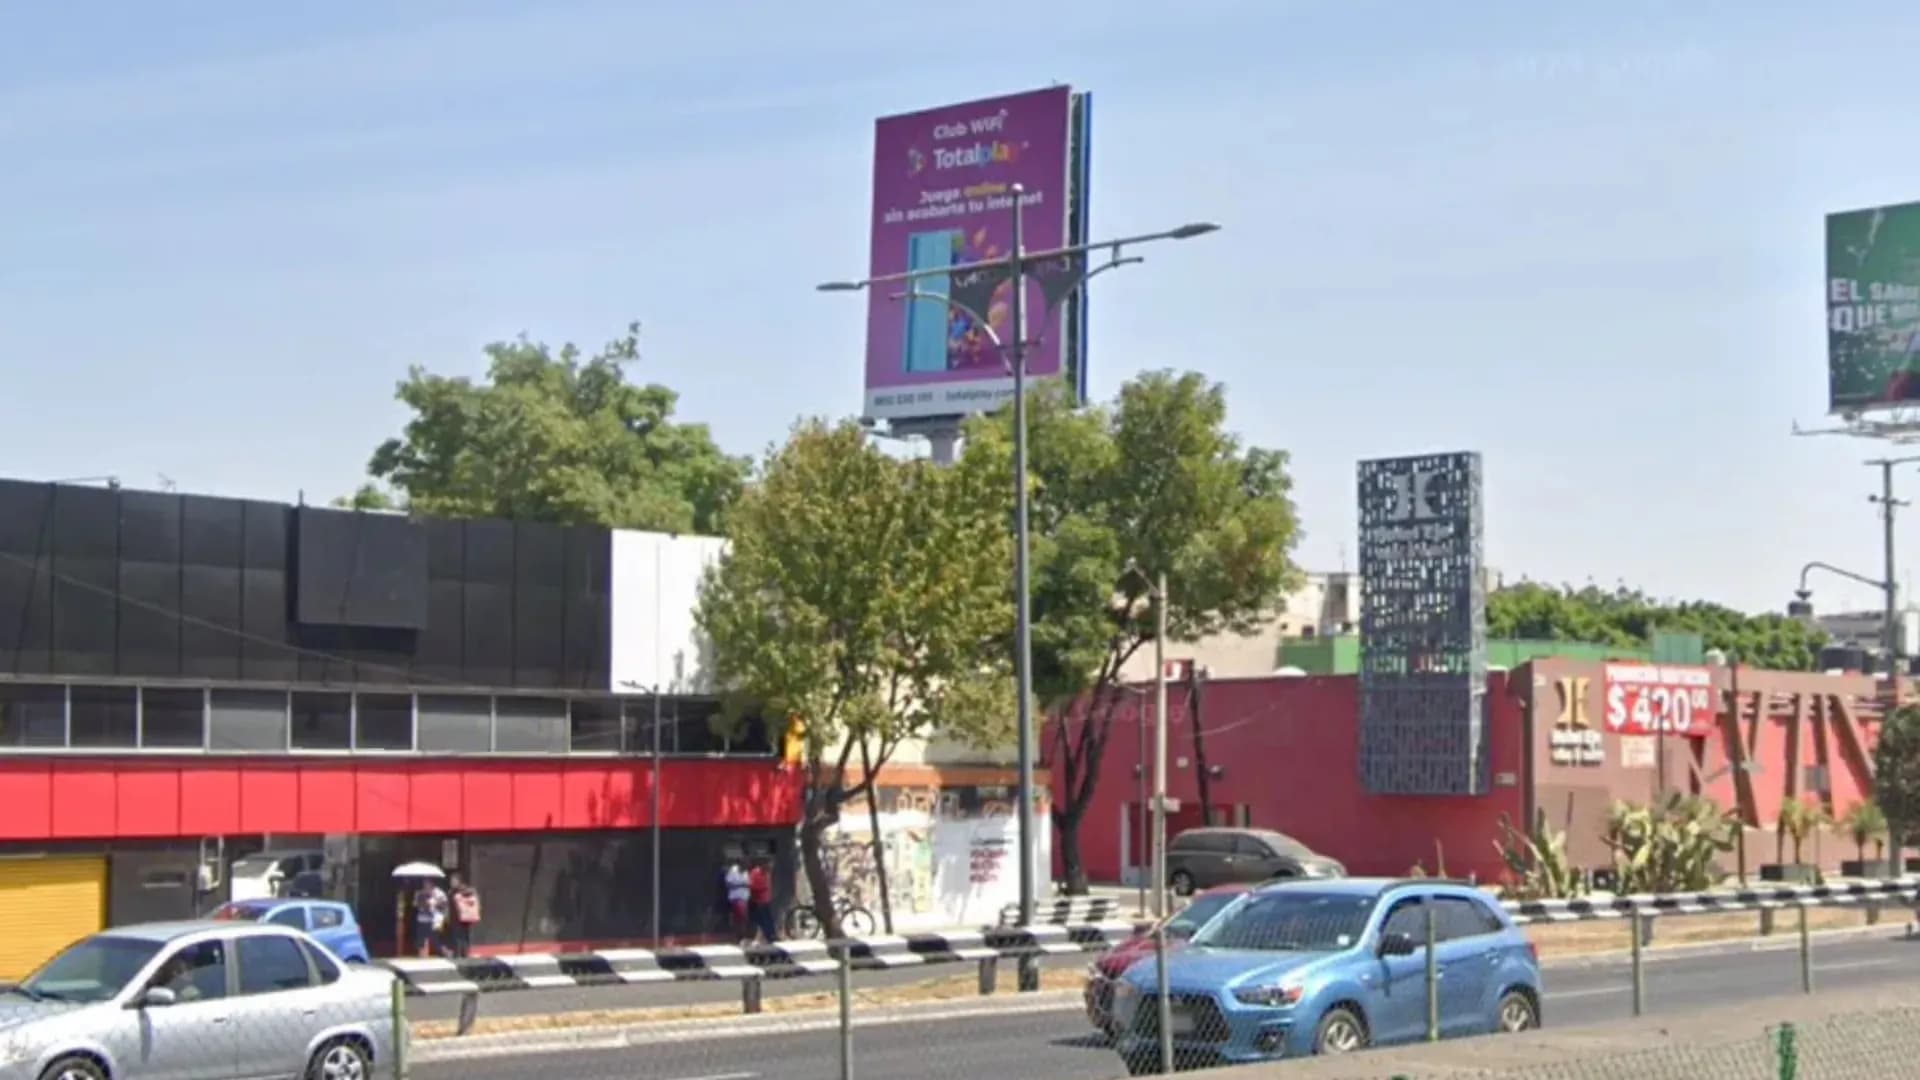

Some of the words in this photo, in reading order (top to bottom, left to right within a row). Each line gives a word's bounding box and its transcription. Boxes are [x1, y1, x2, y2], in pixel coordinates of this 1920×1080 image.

[933, 122, 967, 140] Club
[986, 191, 1043, 210] intenet
[1831, 278, 1865, 302] EL
[1831, 302, 1888, 332] QUE
